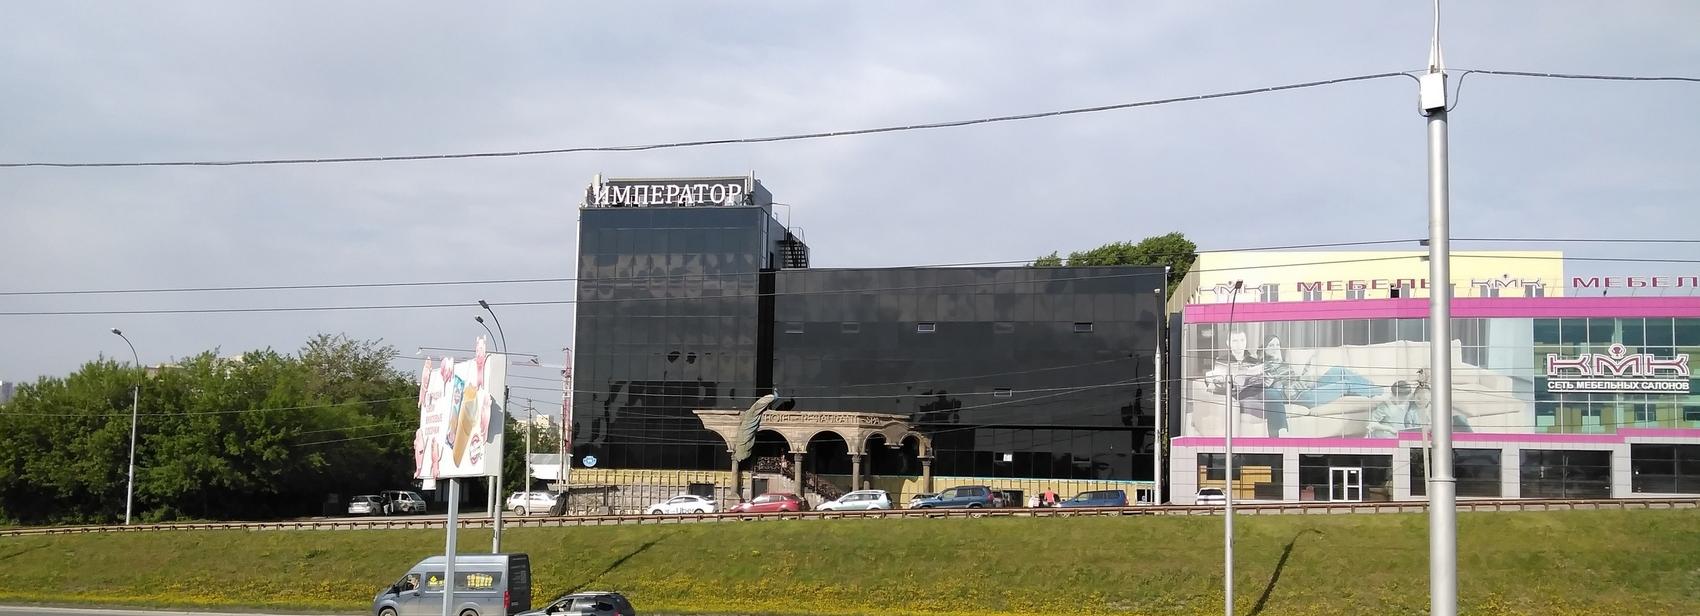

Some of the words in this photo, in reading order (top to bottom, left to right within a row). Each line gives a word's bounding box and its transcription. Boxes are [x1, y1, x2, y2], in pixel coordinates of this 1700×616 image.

[594, 183, 742, 205] ИМПЕРАТОР
[1547, 352, 1690, 376] КМК
[1547, 381, 1574, 390] СЕТЬ
[1576, 381, 1640, 390] МЕБЕЛЬНЫХ
[1640, 381, 1690, 390] САЛОНОВ
